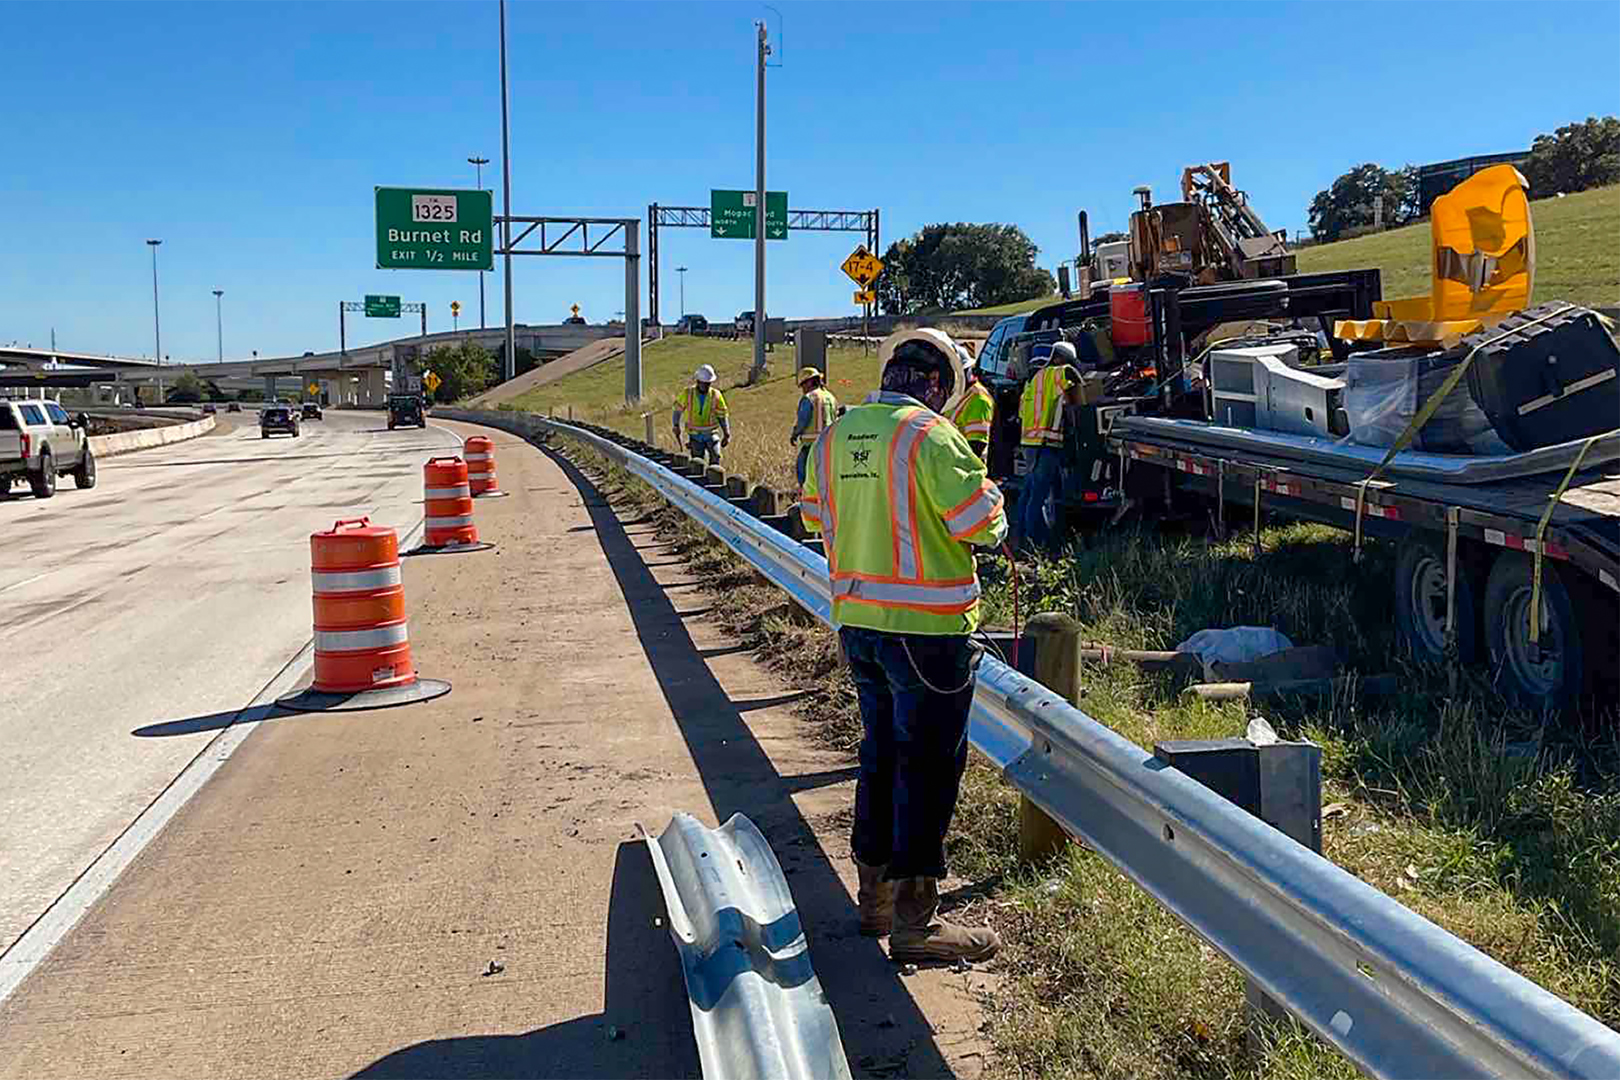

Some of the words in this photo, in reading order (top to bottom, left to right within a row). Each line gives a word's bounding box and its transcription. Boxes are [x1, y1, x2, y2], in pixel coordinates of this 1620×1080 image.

[415, 204, 454, 220] 1325
[388, 228, 450, 243] Burnet
[459, 229, 482, 243] Rd
[391, 250, 416, 260] EXIT
[452, 251, 479, 262] MILE
